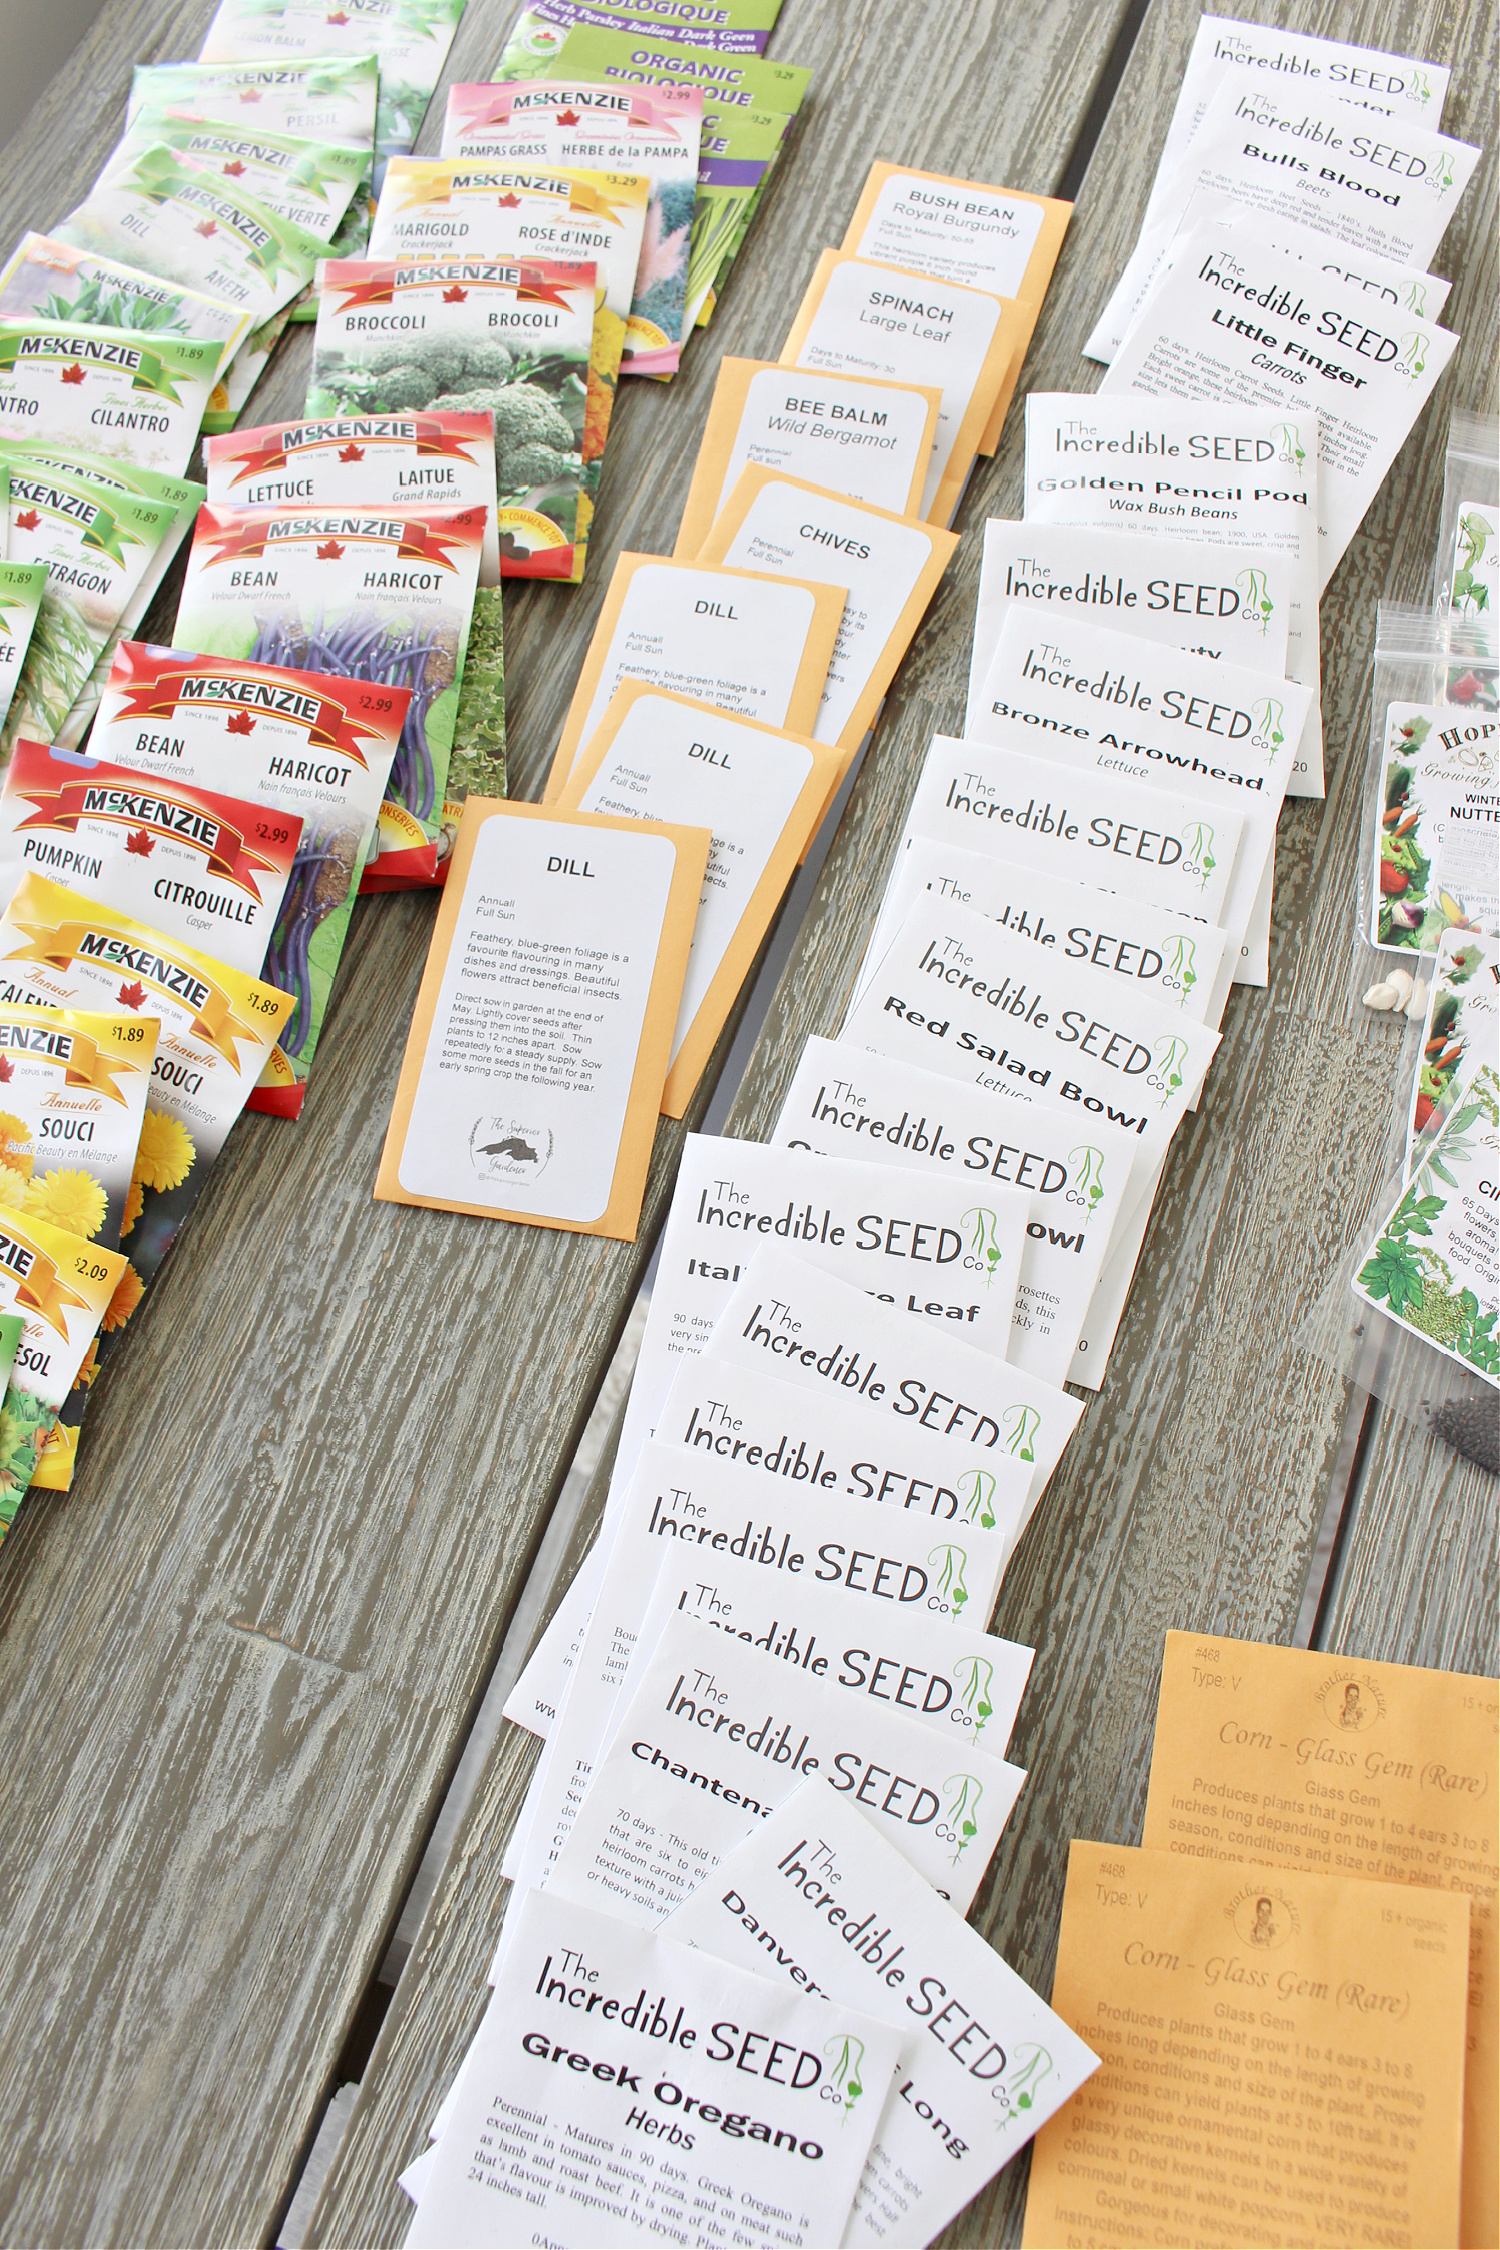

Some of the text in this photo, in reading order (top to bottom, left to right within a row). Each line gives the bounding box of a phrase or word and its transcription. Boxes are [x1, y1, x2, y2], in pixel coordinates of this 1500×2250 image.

[678, 26, 716, 42] Dark
[630, 51, 744, 84] ORGANIC
[1252, 93, 1278, 113] The
[287, 112, 339, 127] PERSIL
[460, 144, 689, 159] PAMPAS GRASS HERBE de la PAMPA
[1235, 97, 1343, 149] Incredible
[1349, 138, 1427, 178] SEED
[1242, 144, 1401, 207] Bulls Blood
[1296, 180, 1332, 199] Beets
[892, 202, 1020, 239] Royal Burgundy
[910, 190, 1015, 221] BUSH BEAN
[121, 214, 150, 238] DILL
[518, 226, 612, 249] ROSE d'INDE
[1219, 252, 1245, 277] The
[205, 270, 250, 302] ANETH
[345, 313, 559, 331] BROCCOLI BROCOLI
[869, 292, 954, 324] SPINACH
[1198, 256, 1311, 325] Incredible
[1317, 311, 1398, 363] SEED
[860, 310, 952, 344] Large Leaf
[175, 346, 204, 360] $1.89
[1212, 309, 1368, 390] Little Finger
[1251, 353, 1308, 385] Carrots
[91, 409, 169, 433] CILANTRO
[786, 398, 888, 427] BEE BALM
[768, 416, 898, 451] Wild Bergamot
[1065, 421, 1097, 435] The
[1056, 428, 1275, 462] Incredible SEED
[248, 479, 314, 503] LETTUCE
[399, 468, 455, 486] LAITUE
[1037, 476, 1308, 505] Golden Pencil Pod
[392, 488, 461, 502] Grand Rapids
[1109, 498, 1238, 520] Wax Bush Beans
[799, 524, 871, 560] CHIVES
[1274, 532, 1300, 541] Golden
[694, 600, 739, 620] DILL
[184, 710, 219, 722] SINCE 1896
[358, 694, 392, 712] $2.99
[136, 733, 185, 758] BEAN
[992, 701, 1264, 792] Bronze Arrowhead
[114, 754, 194, 778] Velour Dwarf French
[268, 757, 351, 787] HARICOT
[1096, 755, 1149, 779] Lettuce
[258, 780, 346, 805] Nain français Velours
[24, 839, 103, 879] PUMPKIN
[547, 856, 595, 878] DILL
[154, 879, 258, 926] CITROUILLE
[476, 907, 515, 921] Full Sun
[478, 895, 515, 908] Annuall
[467, 943, 560, 967] favourite flavouring
[470, 931, 608, 963] Feathery, blue-green foliage
[24, 966, 80, 999] Annual
[461, 968, 622, 1001] flowers attract beneficial insects.
[464, 956, 620, 987] dishes dressings. Beautiful
[247, 992, 279, 1016] $1.89
[151, 1056, 204, 1095] SOUCI
[883, 996, 1148, 1134] Red Salad Bowl
[39, 1117, 95, 1142] SOUCI
[491, 1117, 504, 1130] The
[6, 1140, 118, 1163] Pacific Beauty en Mélange
[1462, 1196, 1474, 1209] 65
[1463, 1212, 1498, 1242] flowers,
[1448, 1230, 1492, 1265] bouquets
[74, 1256, 109, 1281] $2.09
[906, 1294, 981, 1324] Leaf
[1018, 1285, 1060, 1304] rosettes
[1195, 1645, 1221, 1663] #468
[692, 1668, 729, 1706] The
[1191, 1666, 1242, 1691] Type: V
[666, 1674, 821, 1777] Incredible
[828, 1752, 940, 1828] SEED
[1219, 1720, 1490, 1800] Corn Glass Gem (Rare)
[1193, 1776, 1375, 1831] Produces plants that grow
[609, 1824, 672, 1862] that are six
[595, 1854, 656, 1892] texture with
[602, 1838, 685, 1887] heirloom carrots
[808, 1839, 842, 1885] The
[777, 1839, 907, 1990] Incredible
[906, 1977, 1008, 2081] SEED
[522, 2031, 824, 2161] Greek Oregano
[625, 2106, 697, 2152] Herbs
[901, 2080, 971, 2160] Long
[486, 2116, 602, 2167] excellent tomato
[492, 2095, 792, 2223] Perennial Matures Oregano
